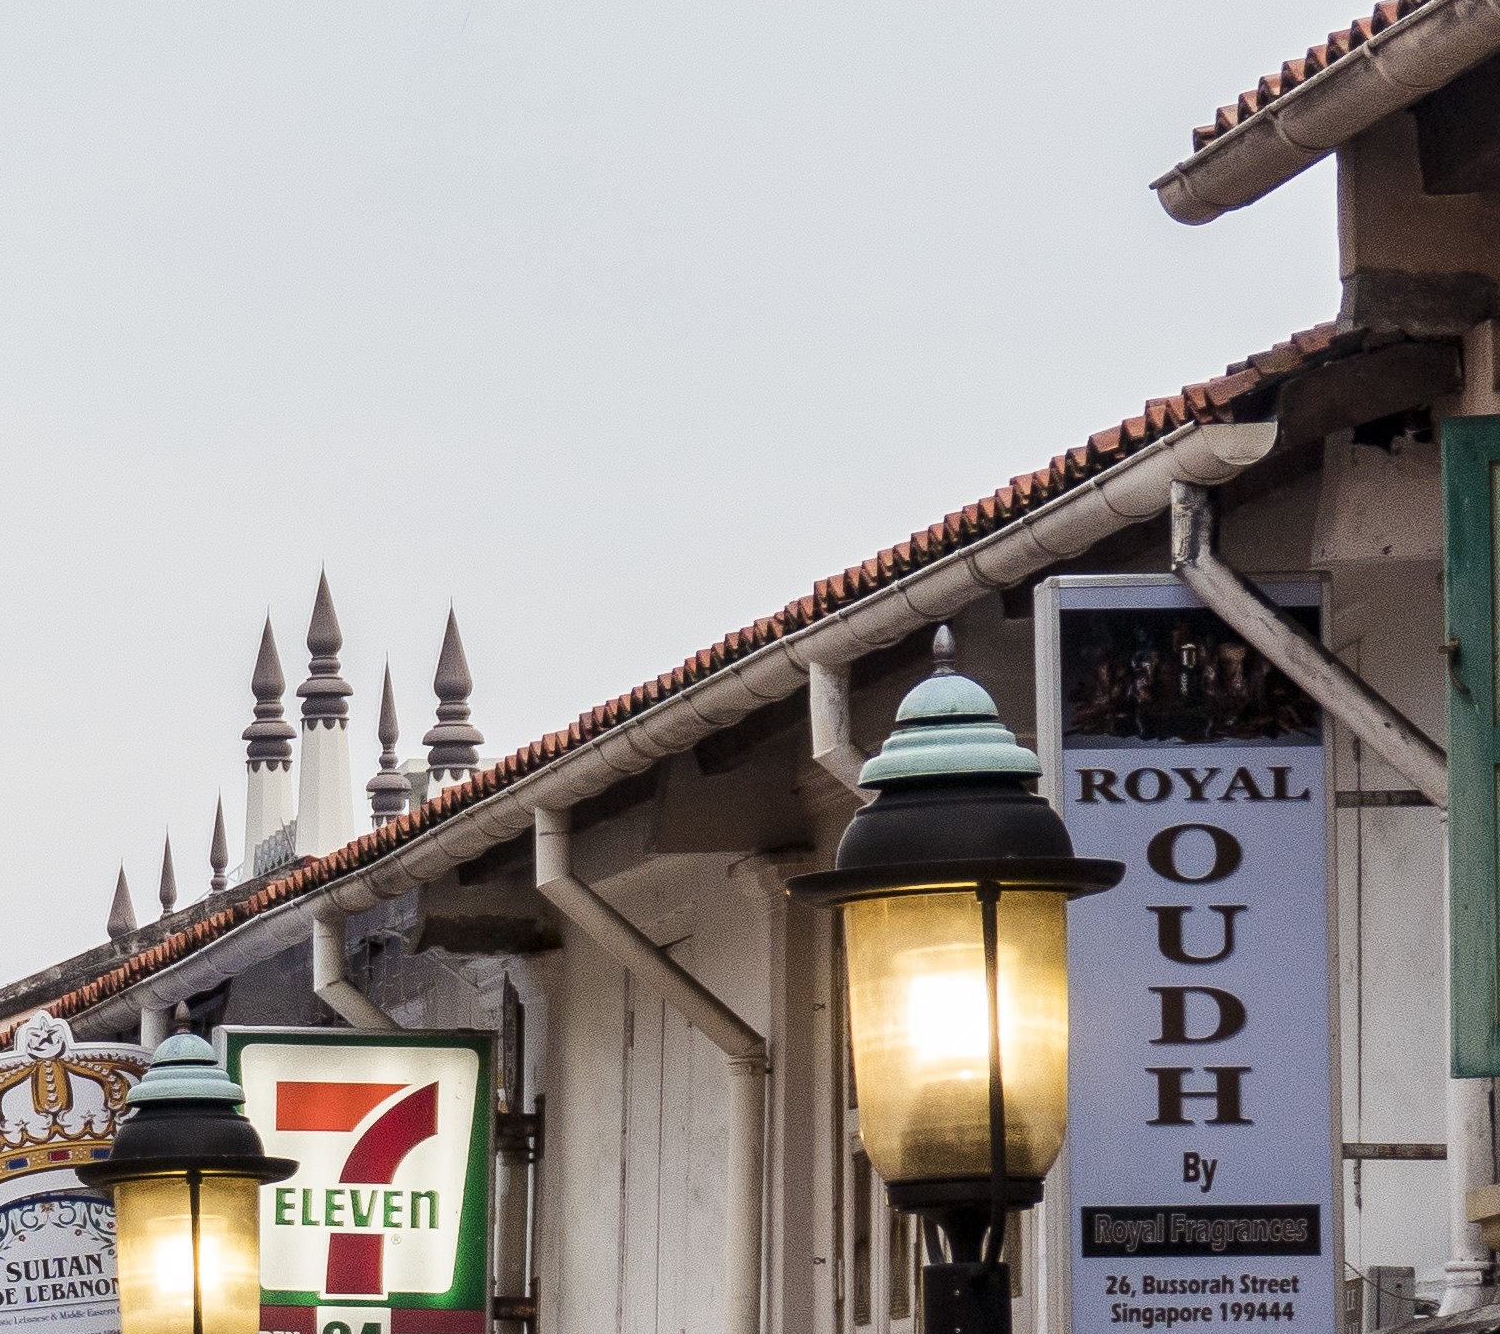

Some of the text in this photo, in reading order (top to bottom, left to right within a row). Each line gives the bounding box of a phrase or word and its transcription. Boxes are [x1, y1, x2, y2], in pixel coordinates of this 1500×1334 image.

[1074, 766, 1311, 805] ROYAL
[1144, 822, 1255, 1127] OUDH
[275, 1080, 440, 1295] 7
[1182, 1151, 1218, 1193] By
[1094, 1213, 1308, 1252] Royal Fragrances
[6, 1253, 105, 1283] SULTAN
[1105, 1273, 1300, 1298] 26, Bussorah Street
[14, 1316, 50, 1325] Lebanese
[59, 1310, 86, 1320] Middle
[87, 1307, 116, 1317] Eastern
[1111, 1301, 1295, 1329] Singapore 199444
